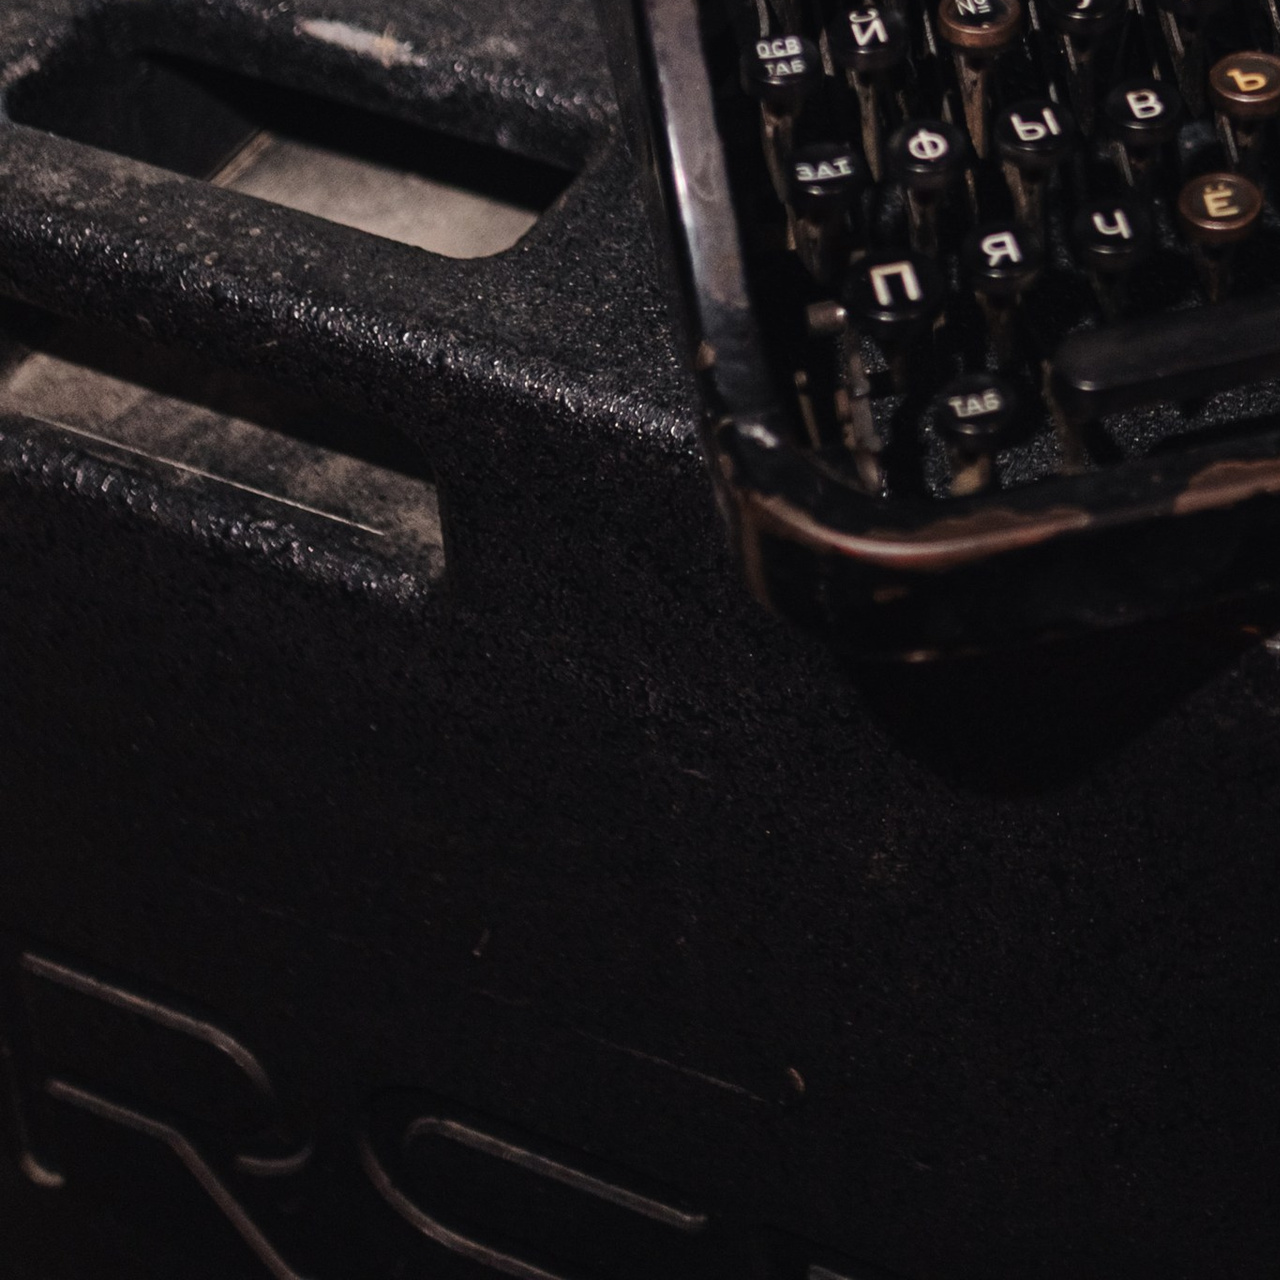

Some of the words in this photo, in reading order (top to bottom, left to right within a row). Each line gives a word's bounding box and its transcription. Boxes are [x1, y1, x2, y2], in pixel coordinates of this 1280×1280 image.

[849, 9, 888, 47] Й
[1126, 88, 1164, 119] В
[1010, 108, 1060, 141] Ы
[908, 128, 949, 160] Ф
[1203, 181, 1239, 218] Ё
[1092, 210, 1131, 239] Ч
[981, 232, 1021, 267] Я
[870, 262, 921, 306] П
